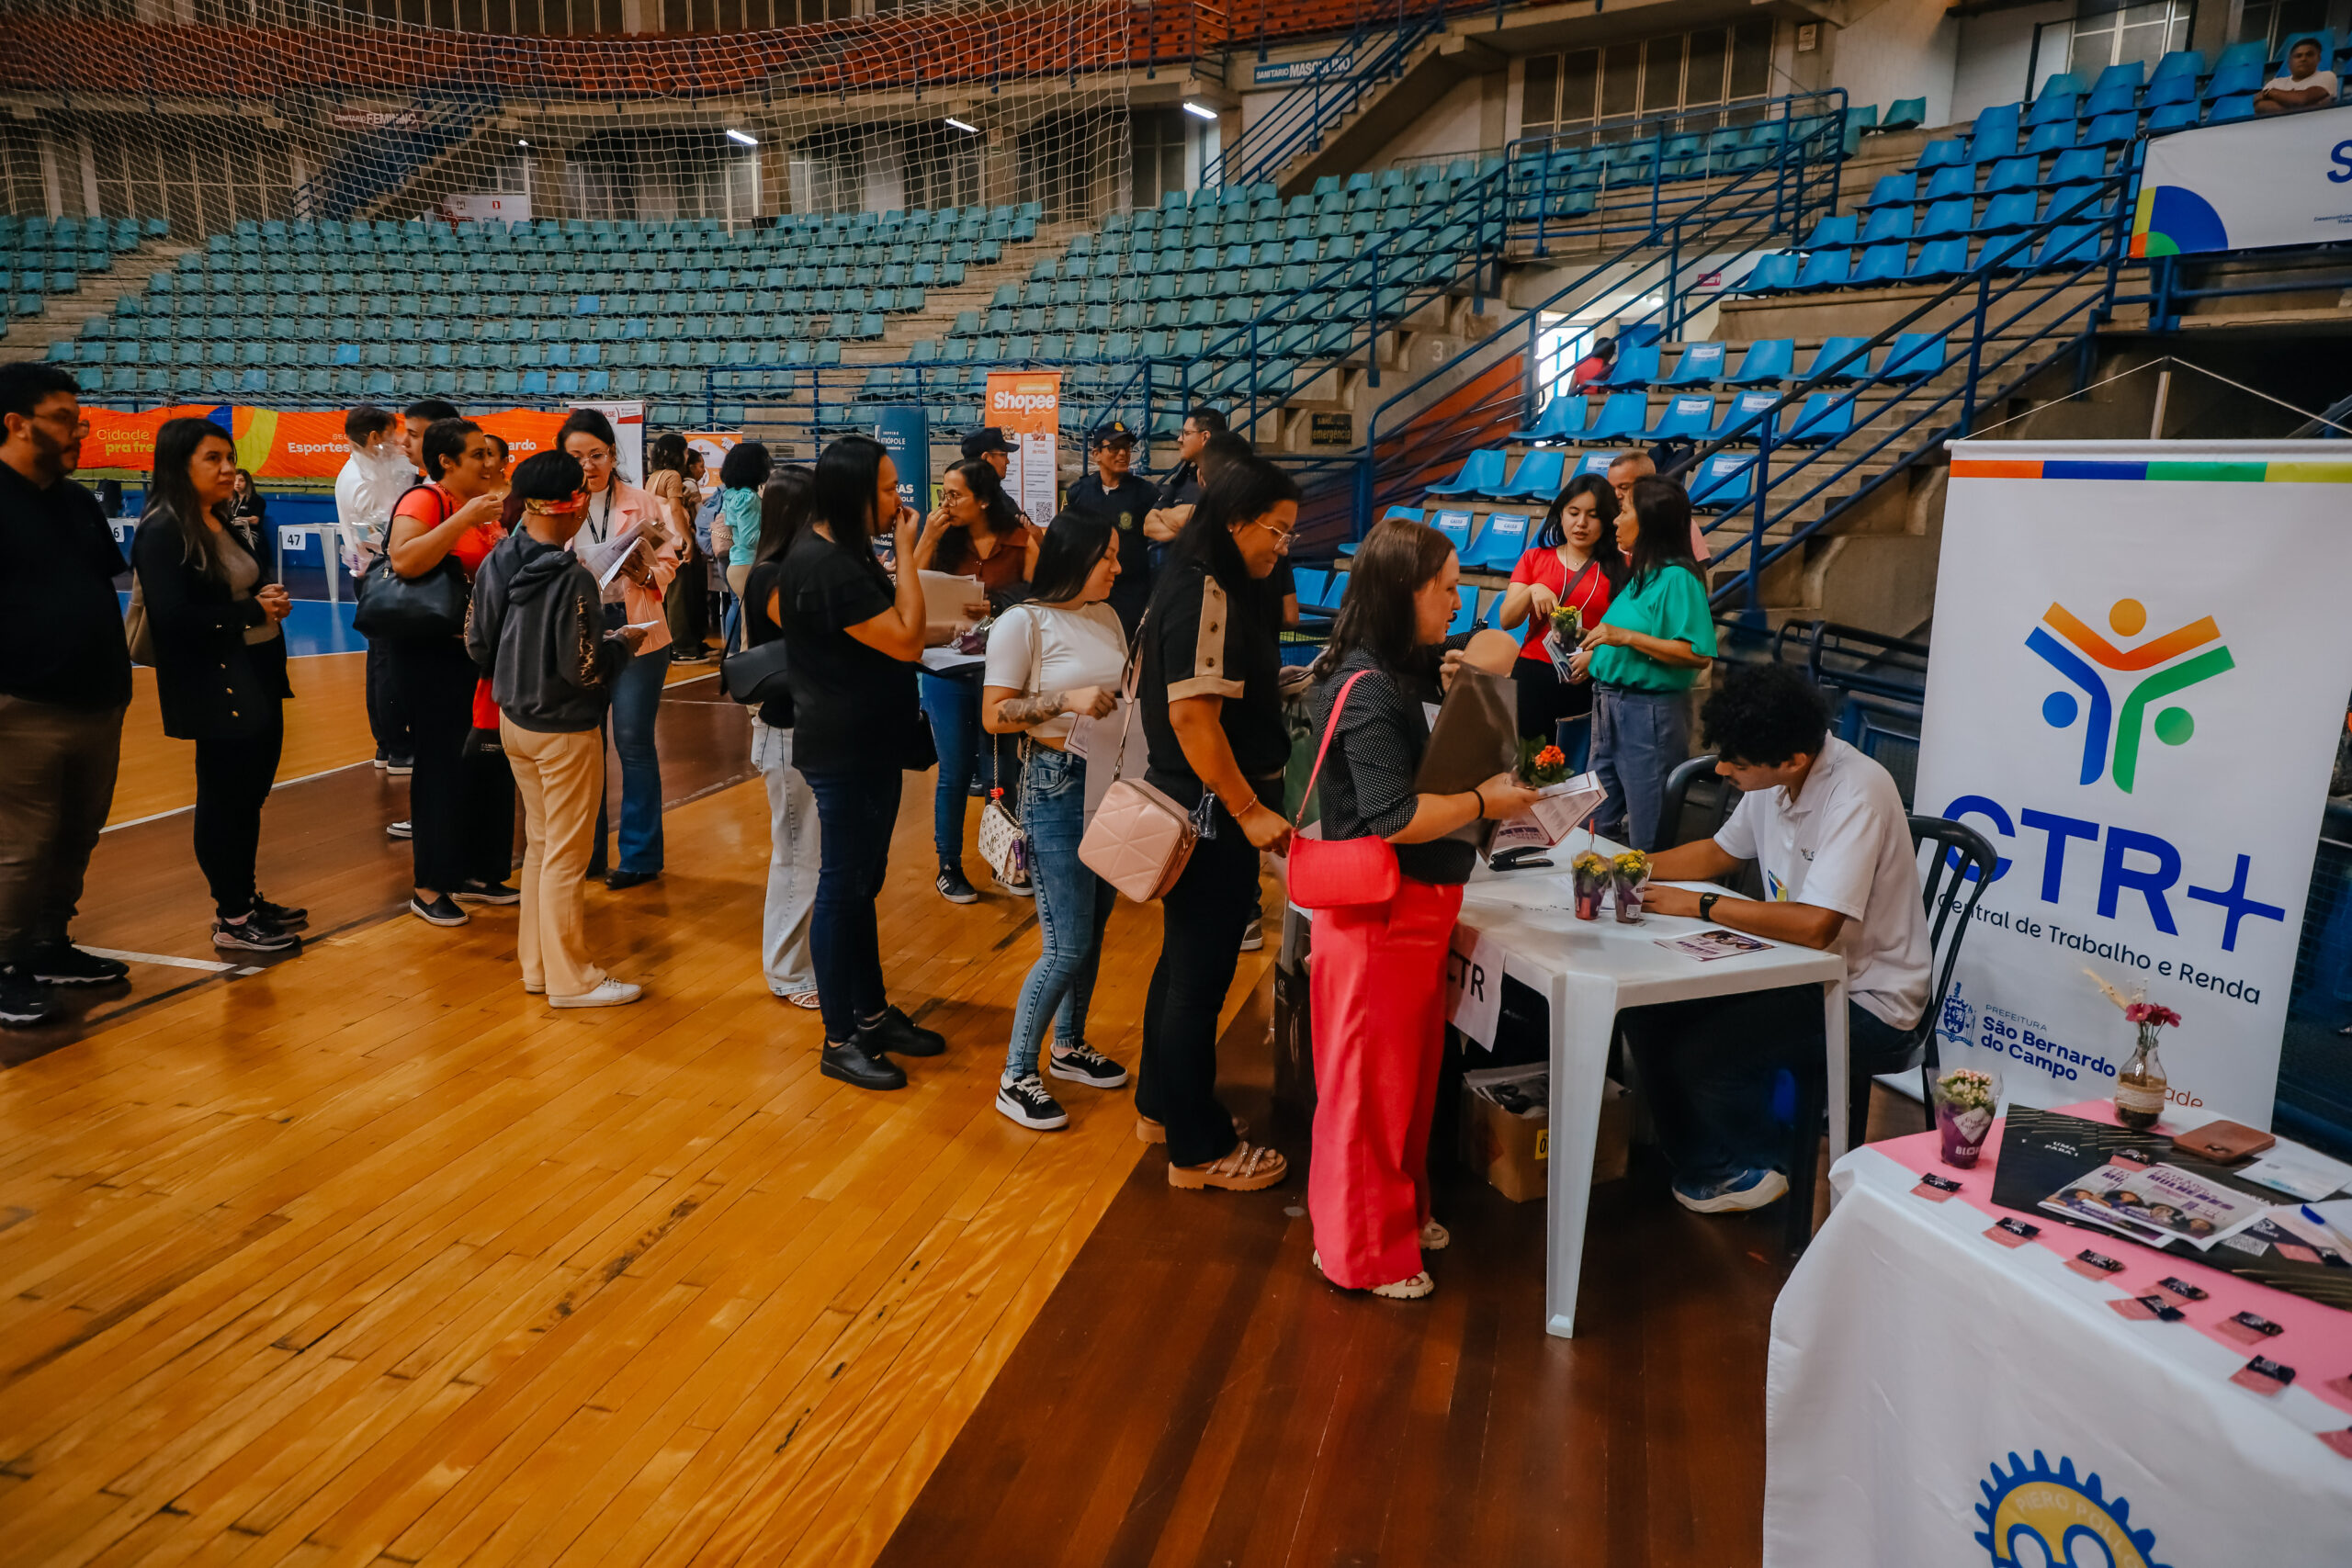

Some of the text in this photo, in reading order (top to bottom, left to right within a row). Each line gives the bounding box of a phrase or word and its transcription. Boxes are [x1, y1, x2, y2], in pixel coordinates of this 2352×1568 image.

[994, 390, 1056, 414] Shopee
[96, 429, 150, 441] Cidade
[106, 443, 130, 456] pra
[288, 442, 350, 455] Esportes
[287, 535, 300, 546] 47
[1941, 795, 2286, 953] CTR+
[2016, 917, 2041, 938] de
[2049, 925, 2151, 969] Trabalho
[2158, 961, 2172, 976] e
[2179, 963, 2260, 1005] Renda
[1985, 1004, 2048, 1032] PREFEITURA
[1981, 1033, 2078, 1081] do Campo
[1983, 1016, 2117, 1077] São Bernardo
[2015, 1490, 2070, 1513] PIERO
